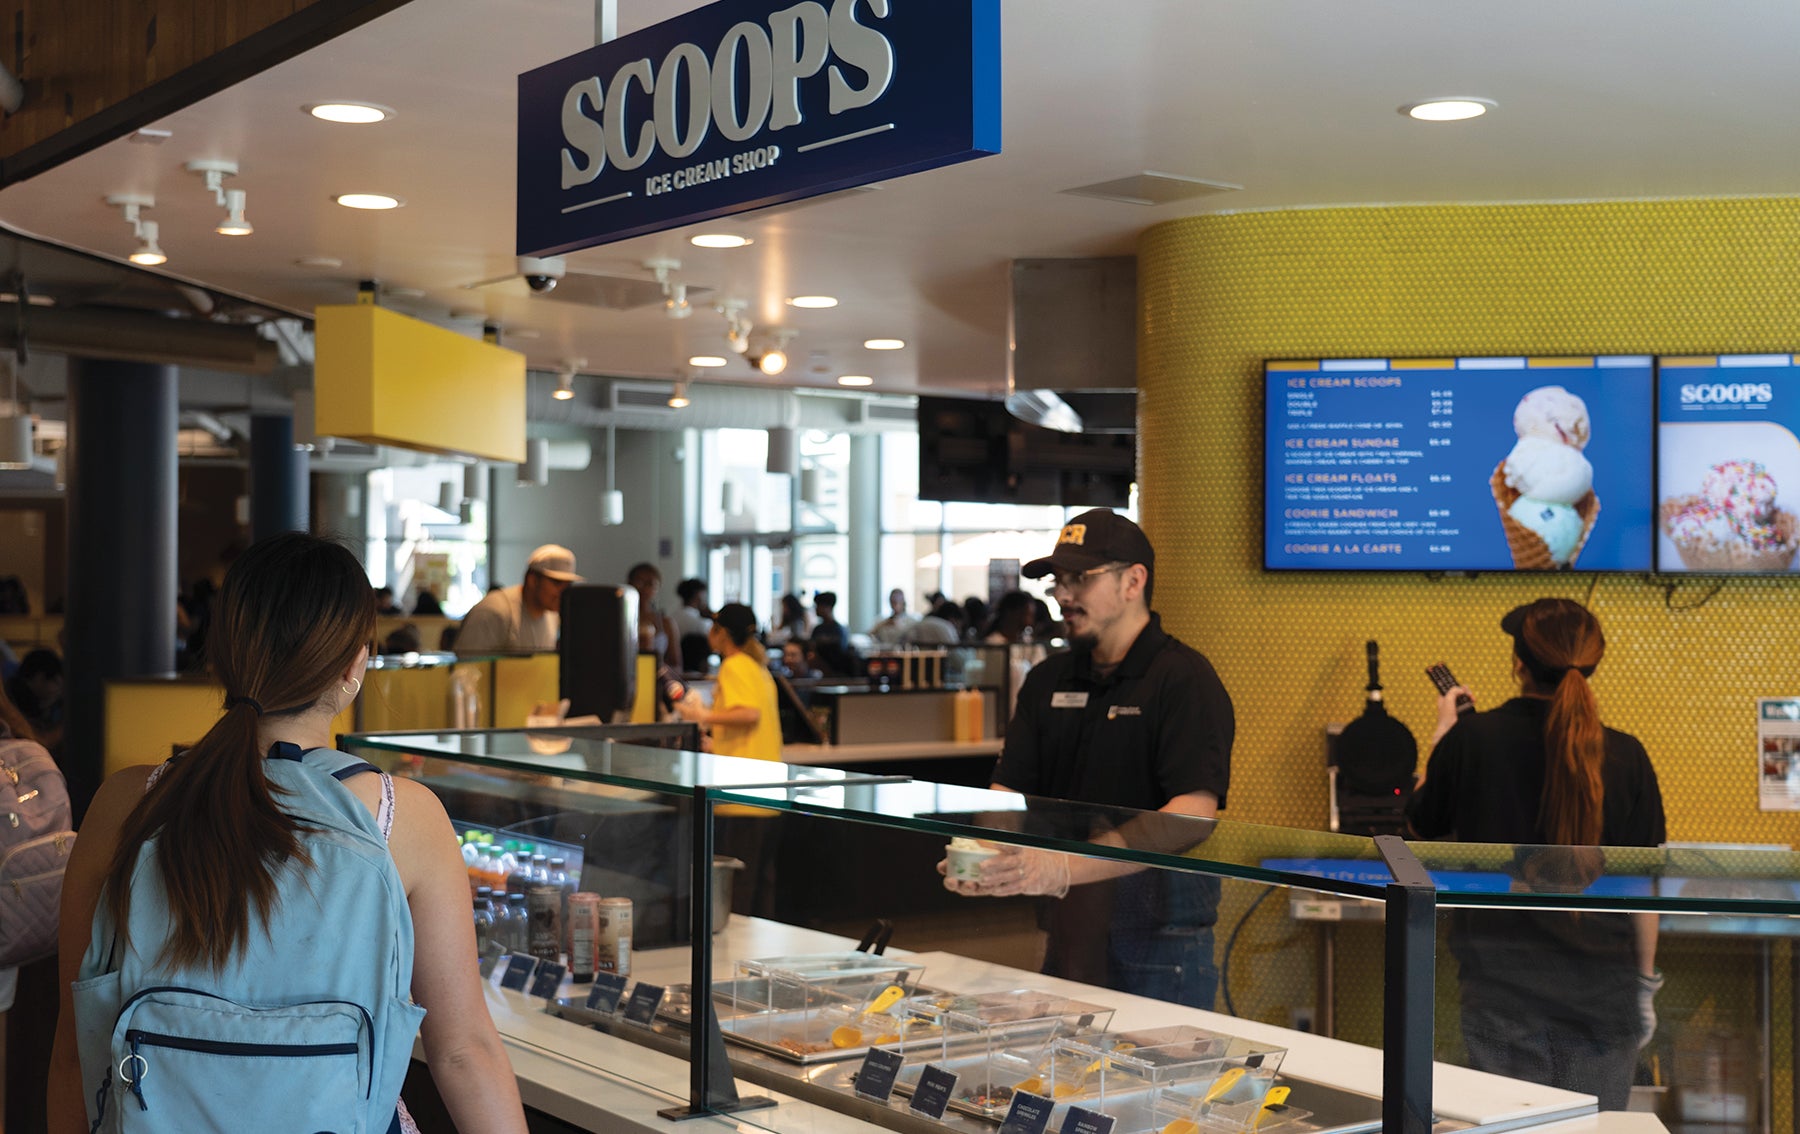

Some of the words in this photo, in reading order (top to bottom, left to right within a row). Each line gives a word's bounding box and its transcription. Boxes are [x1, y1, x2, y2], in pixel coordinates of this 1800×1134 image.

[561, 0, 895, 190] SCOOPS
[645, 170, 672, 197] ICE
[673, 158, 730, 191] CREAM
[732, 145, 781, 176] SHOP
[1286, 377, 1307, 389] ICE
[1309, 377, 1351, 388] CREAM
[1354, 376, 1402, 388] SCOOPS
[1680, 383, 1773, 403] SCOOPS
[1285, 438, 1304, 448] ICE
[1307, 438, 1348, 448] CREAM
[1351, 437, 1400, 448] SUNDAE
[1285, 474, 1304, 484] ICE
[1306, 473, 1348, 483] CREAM
[1350, 473, 1398, 483] FLOATS
[1284, 508, 1330, 519] COOKIE
[1333, 508, 1399, 519] SANDWICH
[1284, 544, 1330, 554] COOKIE
[1333, 544, 1342, 554] A
[1344, 544, 1360, 554] LA
[1363, 544, 1402, 554] CARTE
